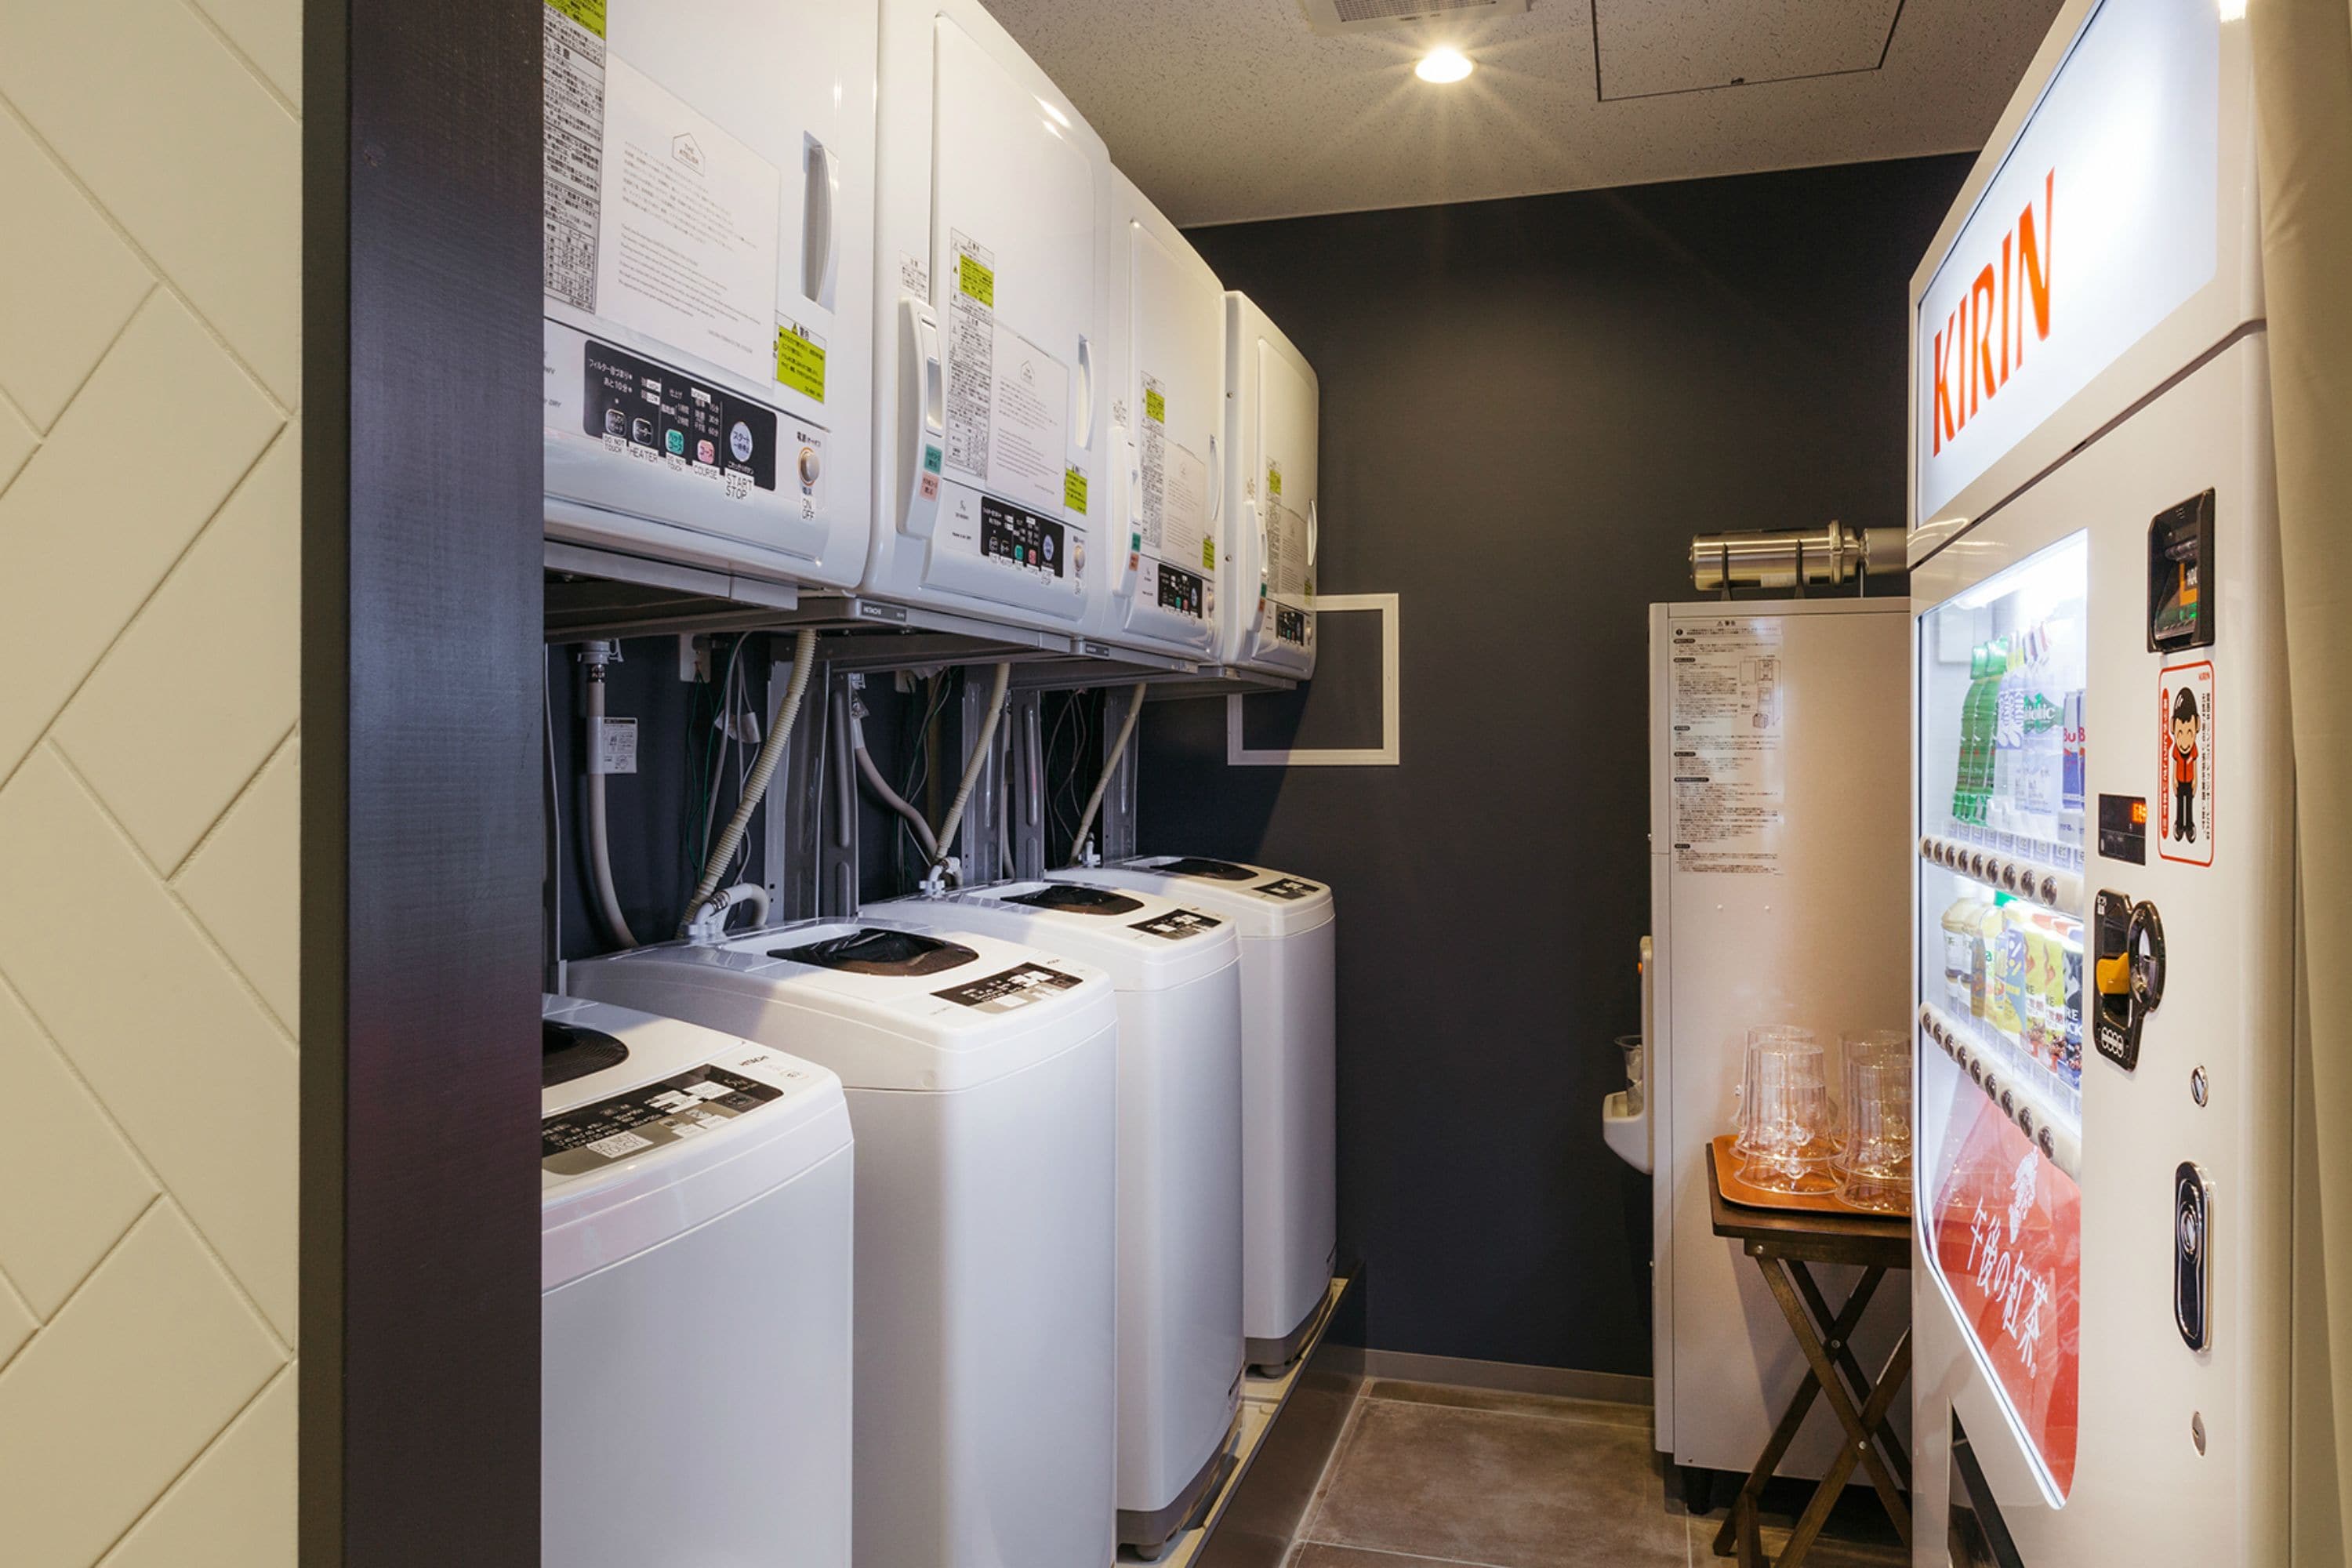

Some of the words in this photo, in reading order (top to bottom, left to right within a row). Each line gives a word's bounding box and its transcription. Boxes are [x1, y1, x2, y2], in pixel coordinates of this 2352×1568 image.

[554, 42, 570, 60] 注意
[1933, 165, 2055, 458] KIRIN
[733, 431, 750, 443] スタート
[630, 444, 659, 463] HEATER
[693, 465, 718, 480] COURSE
[726, 473, 753, 491] START
[726, 486, 747, 499] STOP
[1967, 1195, 2049, 1368] 午後の紅茶
